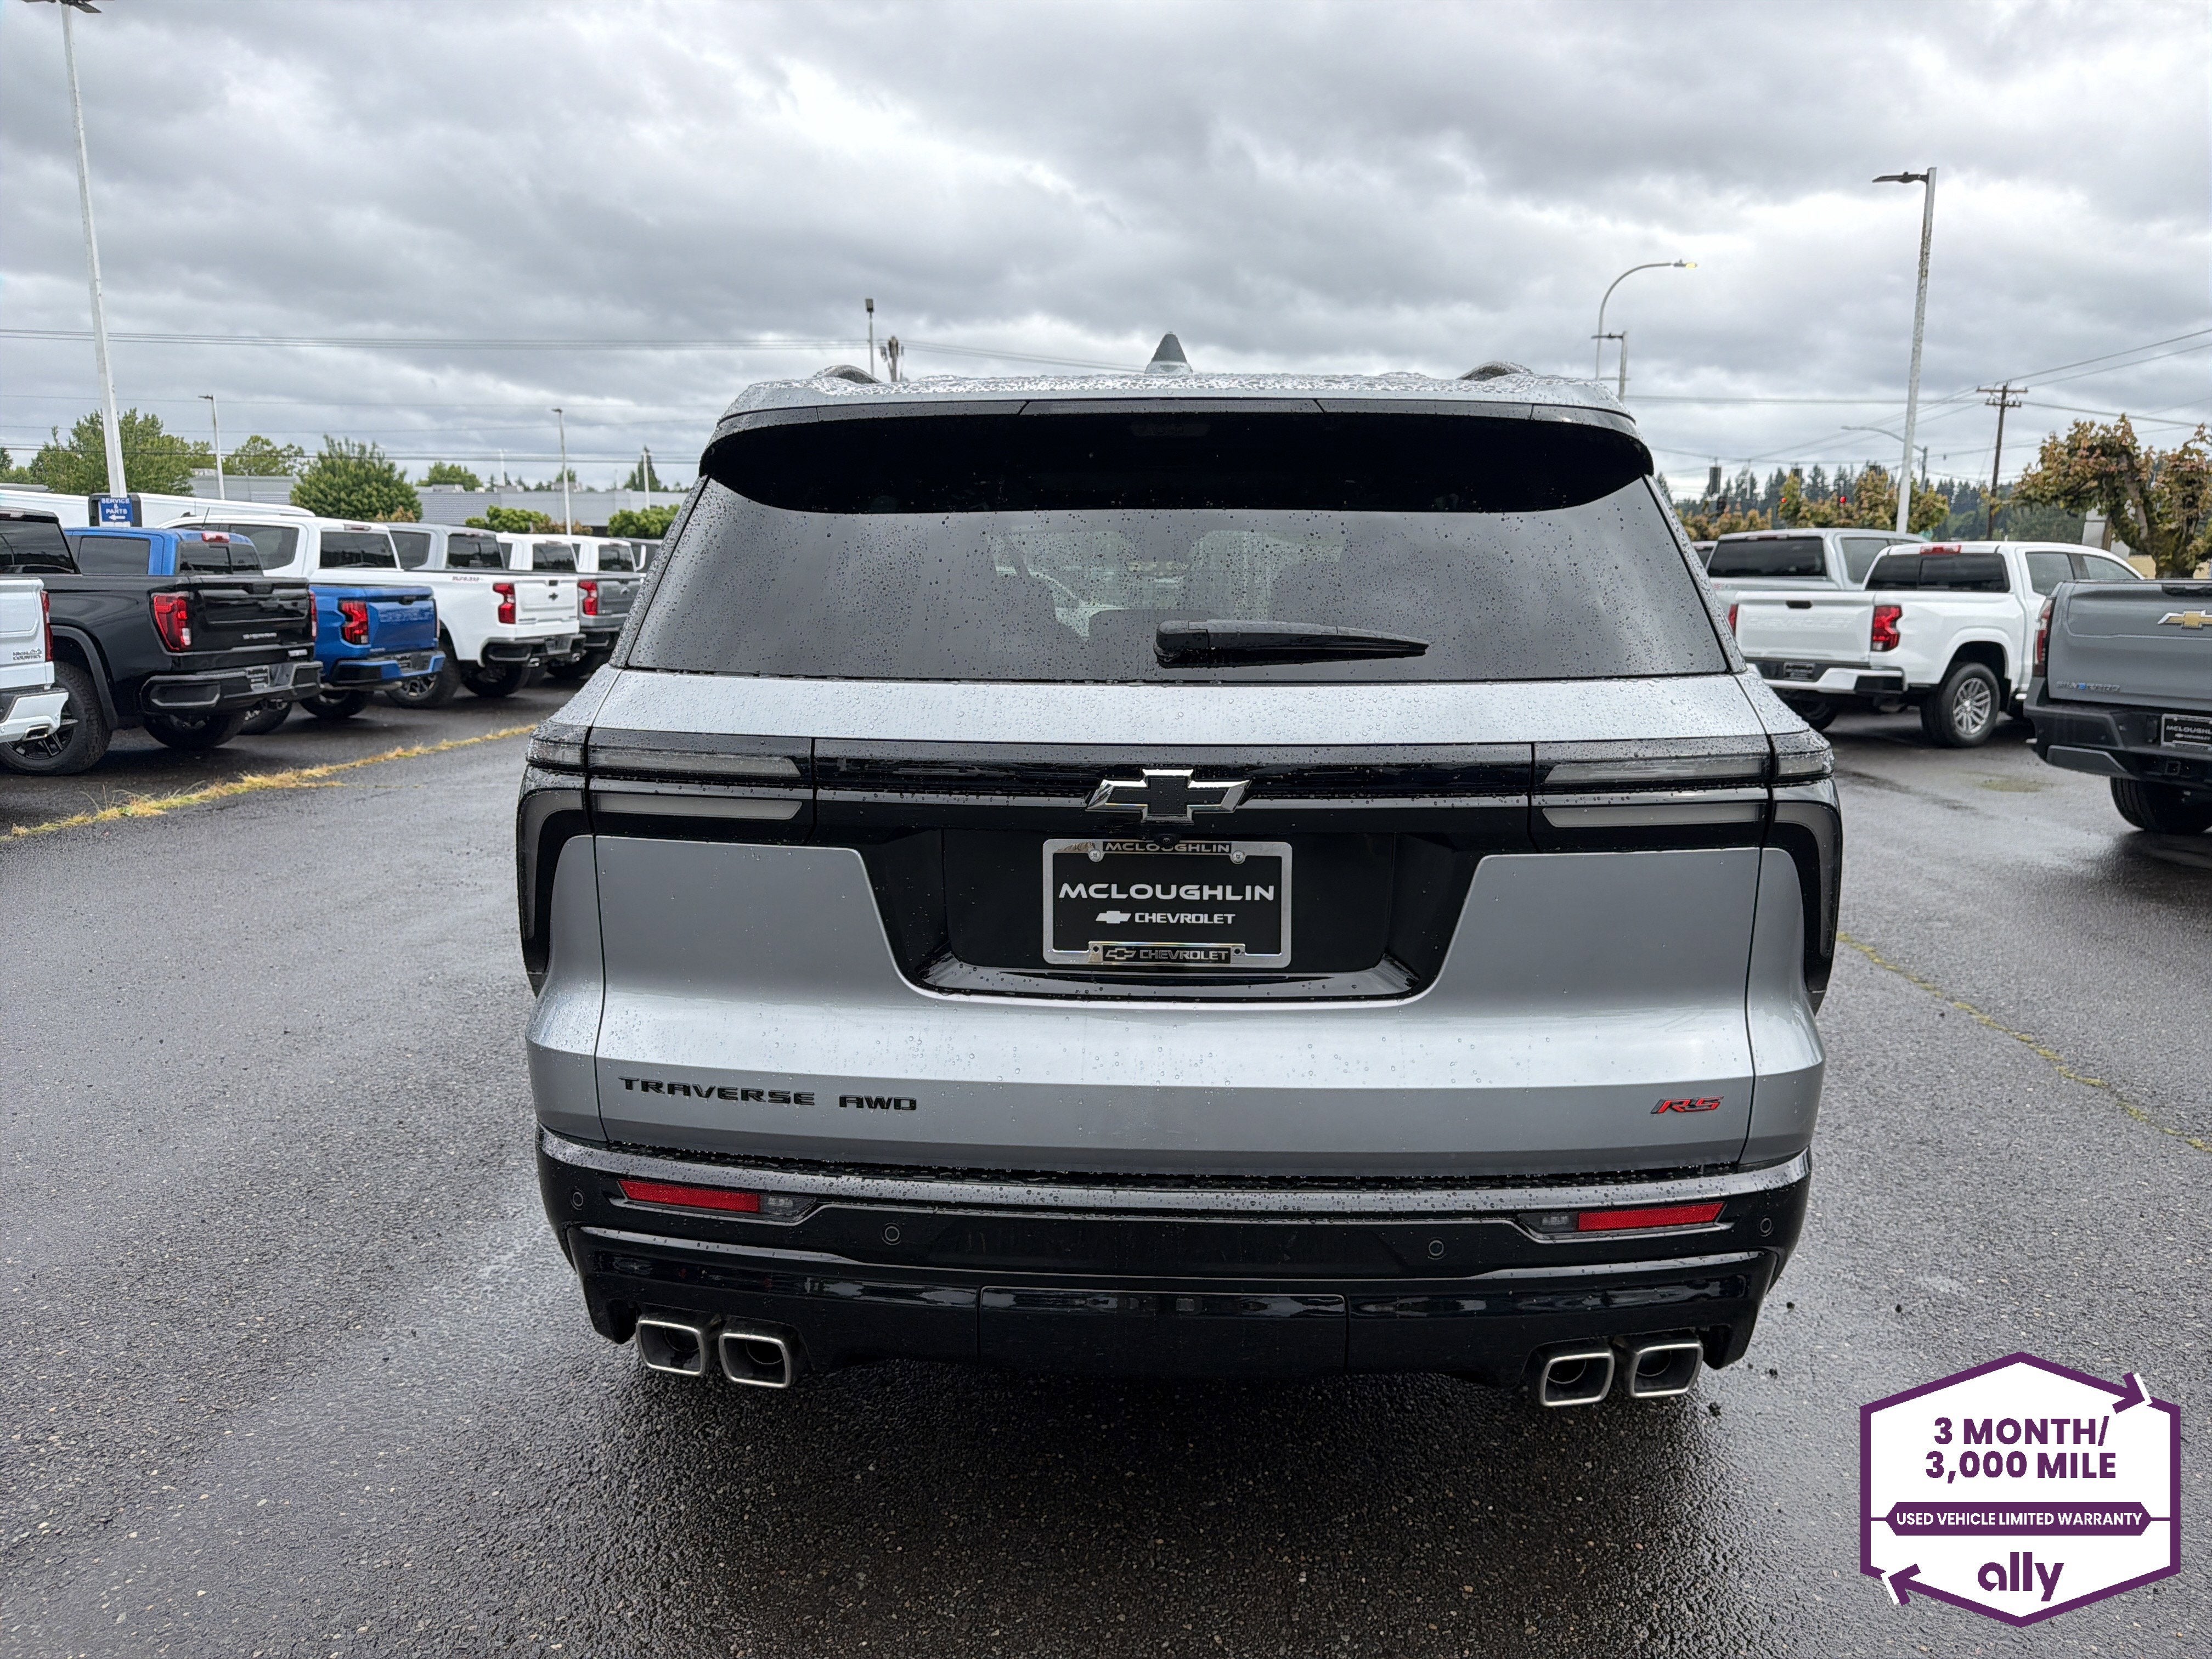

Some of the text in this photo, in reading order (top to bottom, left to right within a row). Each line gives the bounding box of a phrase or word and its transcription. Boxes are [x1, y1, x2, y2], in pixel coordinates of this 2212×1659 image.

[1058, 883, 1274, 901] MCLOUGHLIN
[1135, 912, 1236, 924] CHEVROLET
[1139, 950, 1229, 960] CHEVROLET
[618, 1076, 917, 1110] TRAVERSE AWD
[1651, 1096, 1724, 1114] RS
